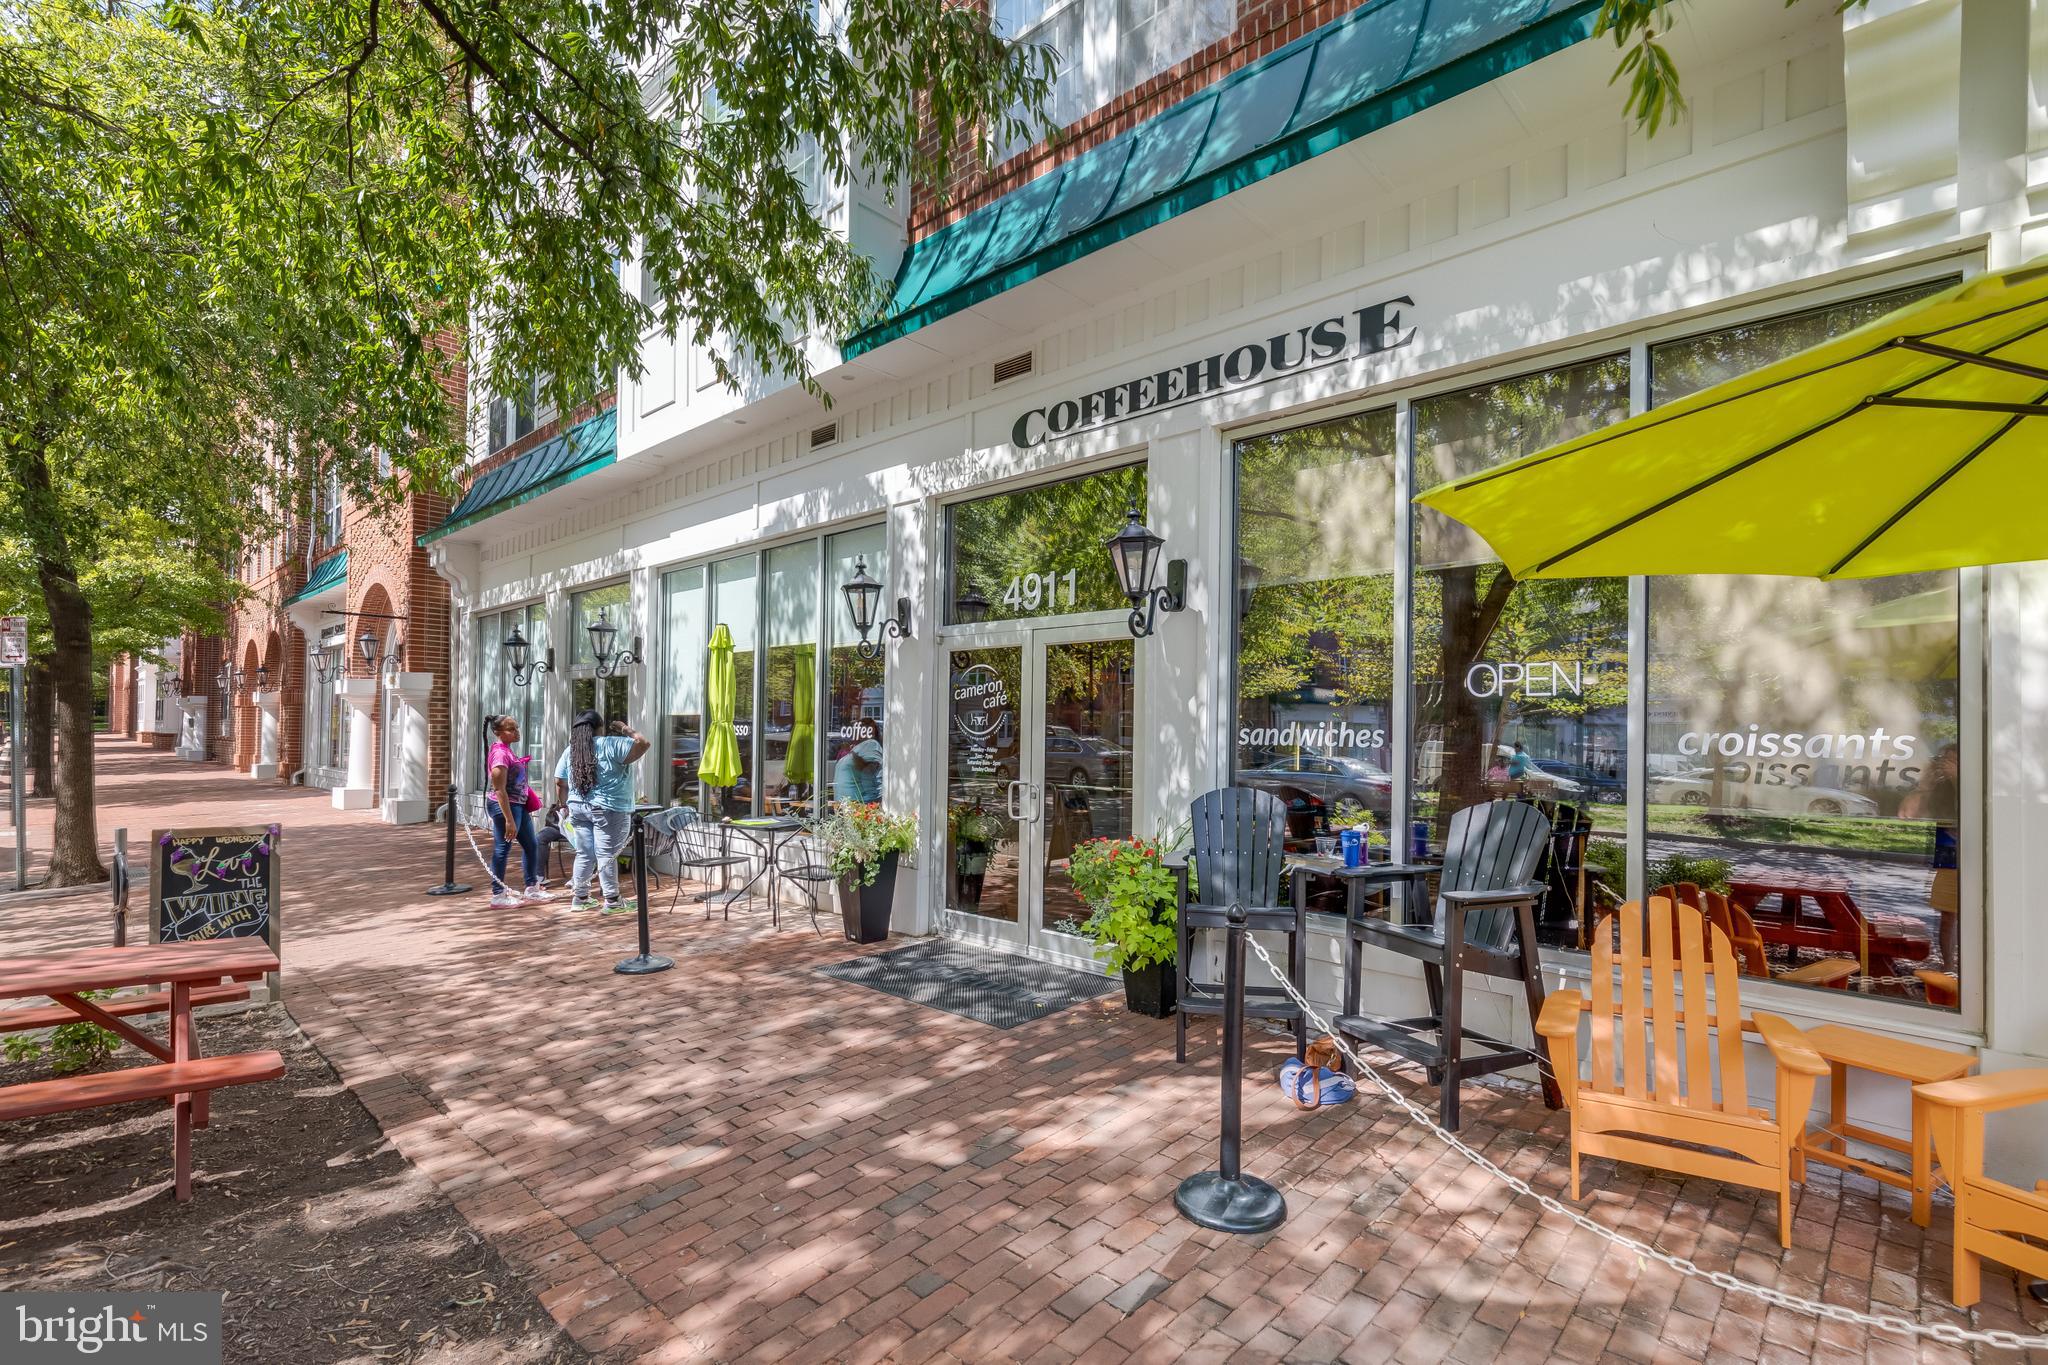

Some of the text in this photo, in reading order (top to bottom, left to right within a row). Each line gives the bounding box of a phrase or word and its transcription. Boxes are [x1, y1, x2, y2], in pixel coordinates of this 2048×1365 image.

[1011, 295, 1418, 449] COFFEEHOUSE
[1003, 568, 1076, 612] 4911
[954, 679, 1003, 700] cameron
[1466, 661, 1582, 698] OPEN
[983, 690, 1007, 709] café
[840, 721, 873, 741] coffee
[1238, 721, 1385, 749] sandwiches
[1678, 723, 1916, 761] croissants
[173, 837, 205, 846] HAPPY
[162, 888, 267, 925] WINE
[217, 908, 252, 929] WITH
